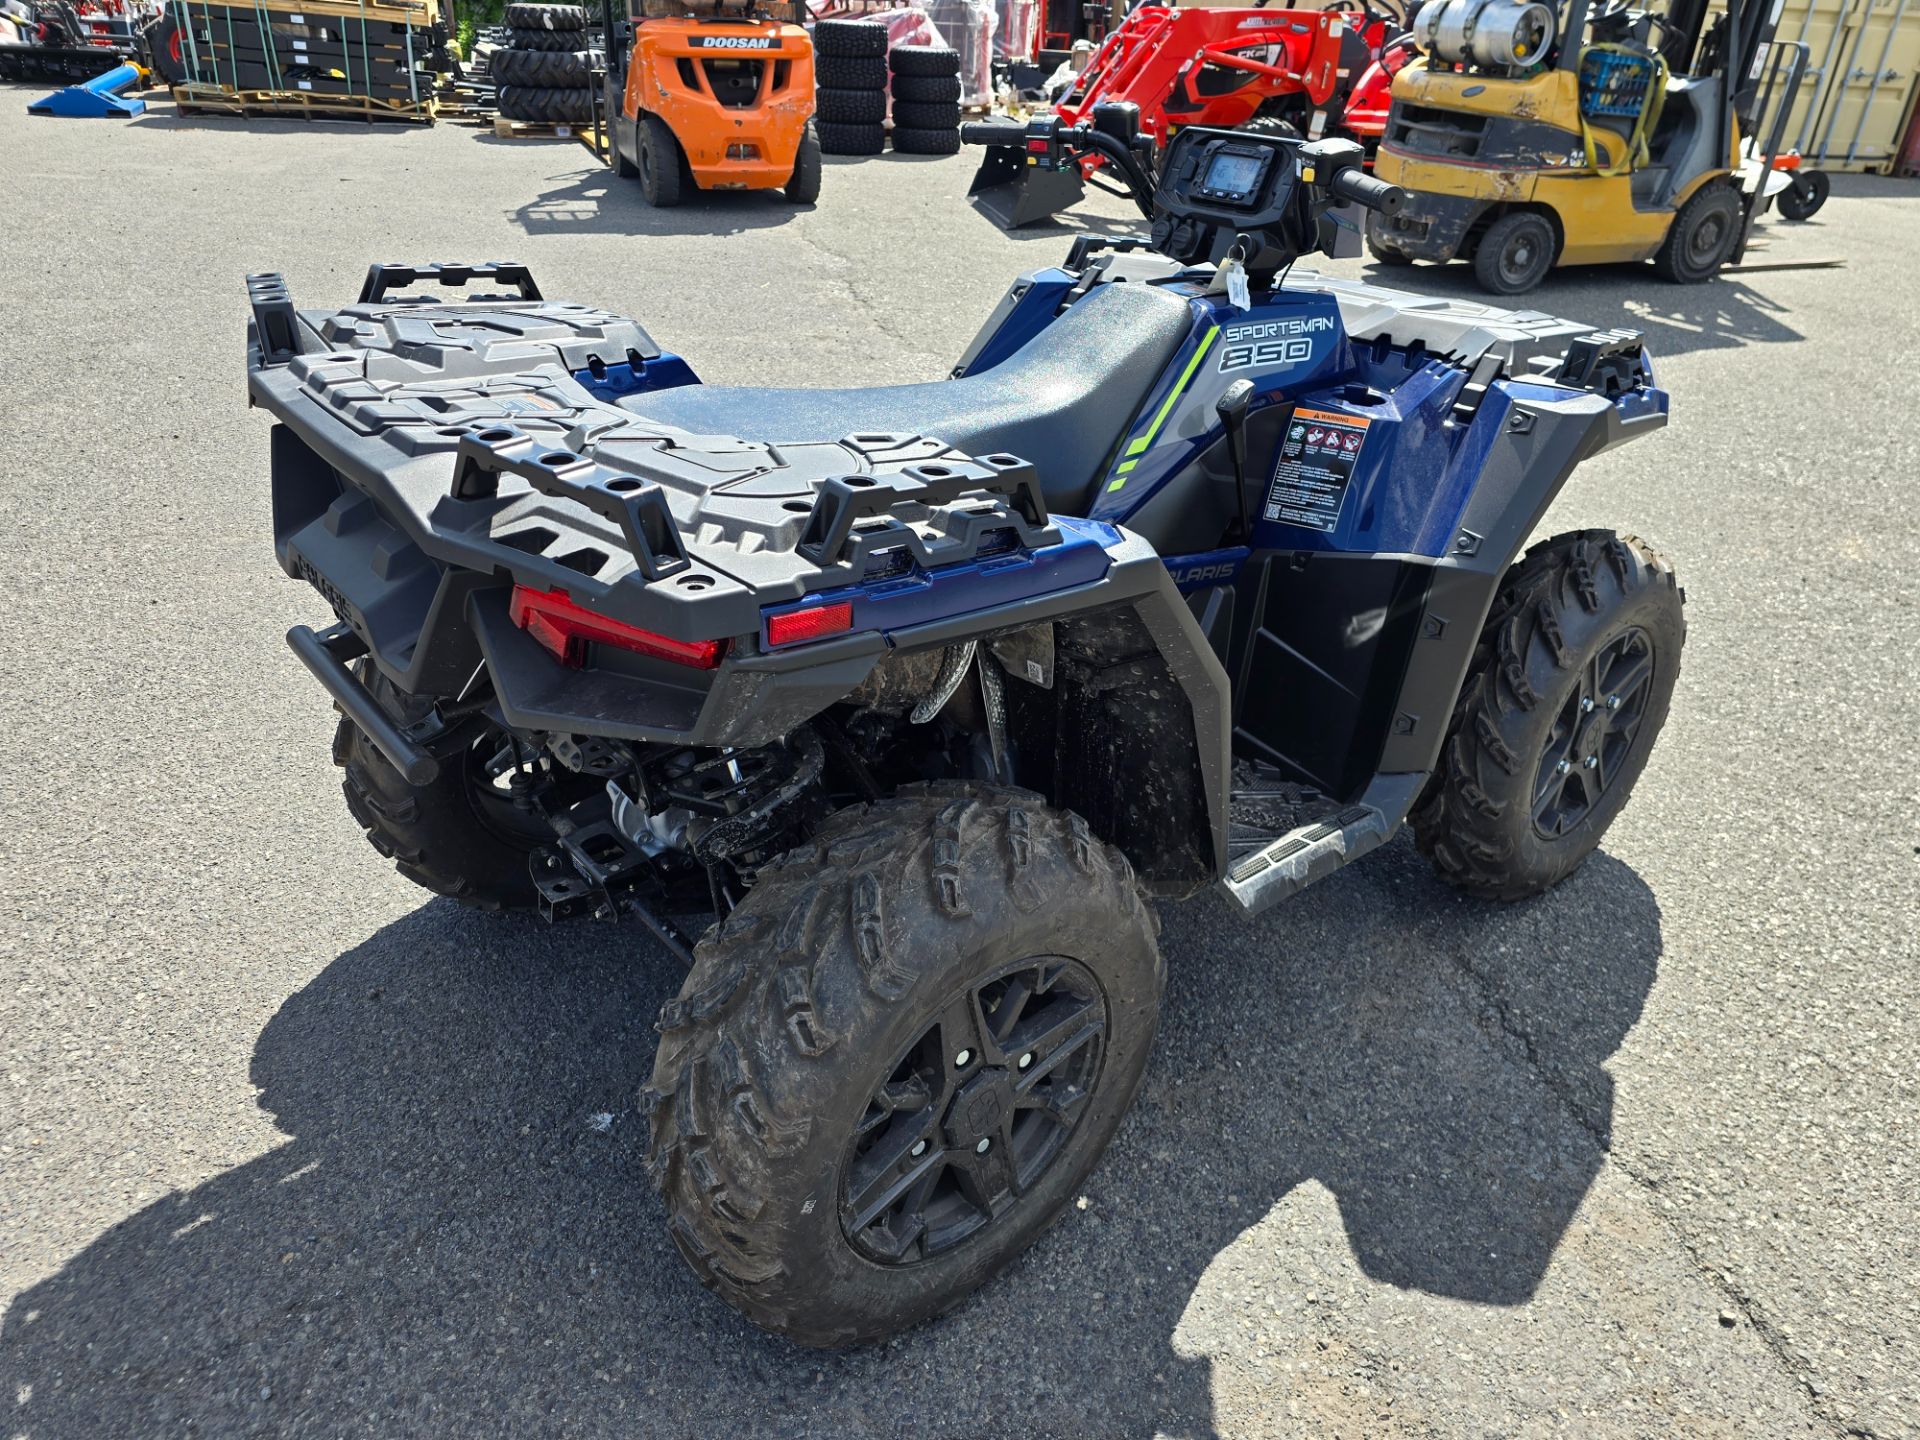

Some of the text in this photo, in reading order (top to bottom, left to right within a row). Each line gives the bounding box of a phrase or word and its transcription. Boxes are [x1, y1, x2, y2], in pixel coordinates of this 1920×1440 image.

[703, 36, 771, 48] DOOSAN
[1225, 316, 1334, 342] SPORTSMAN
[1218, 338, 1312, 374] 850
[1321, 413, 1349, 423] WARNING
